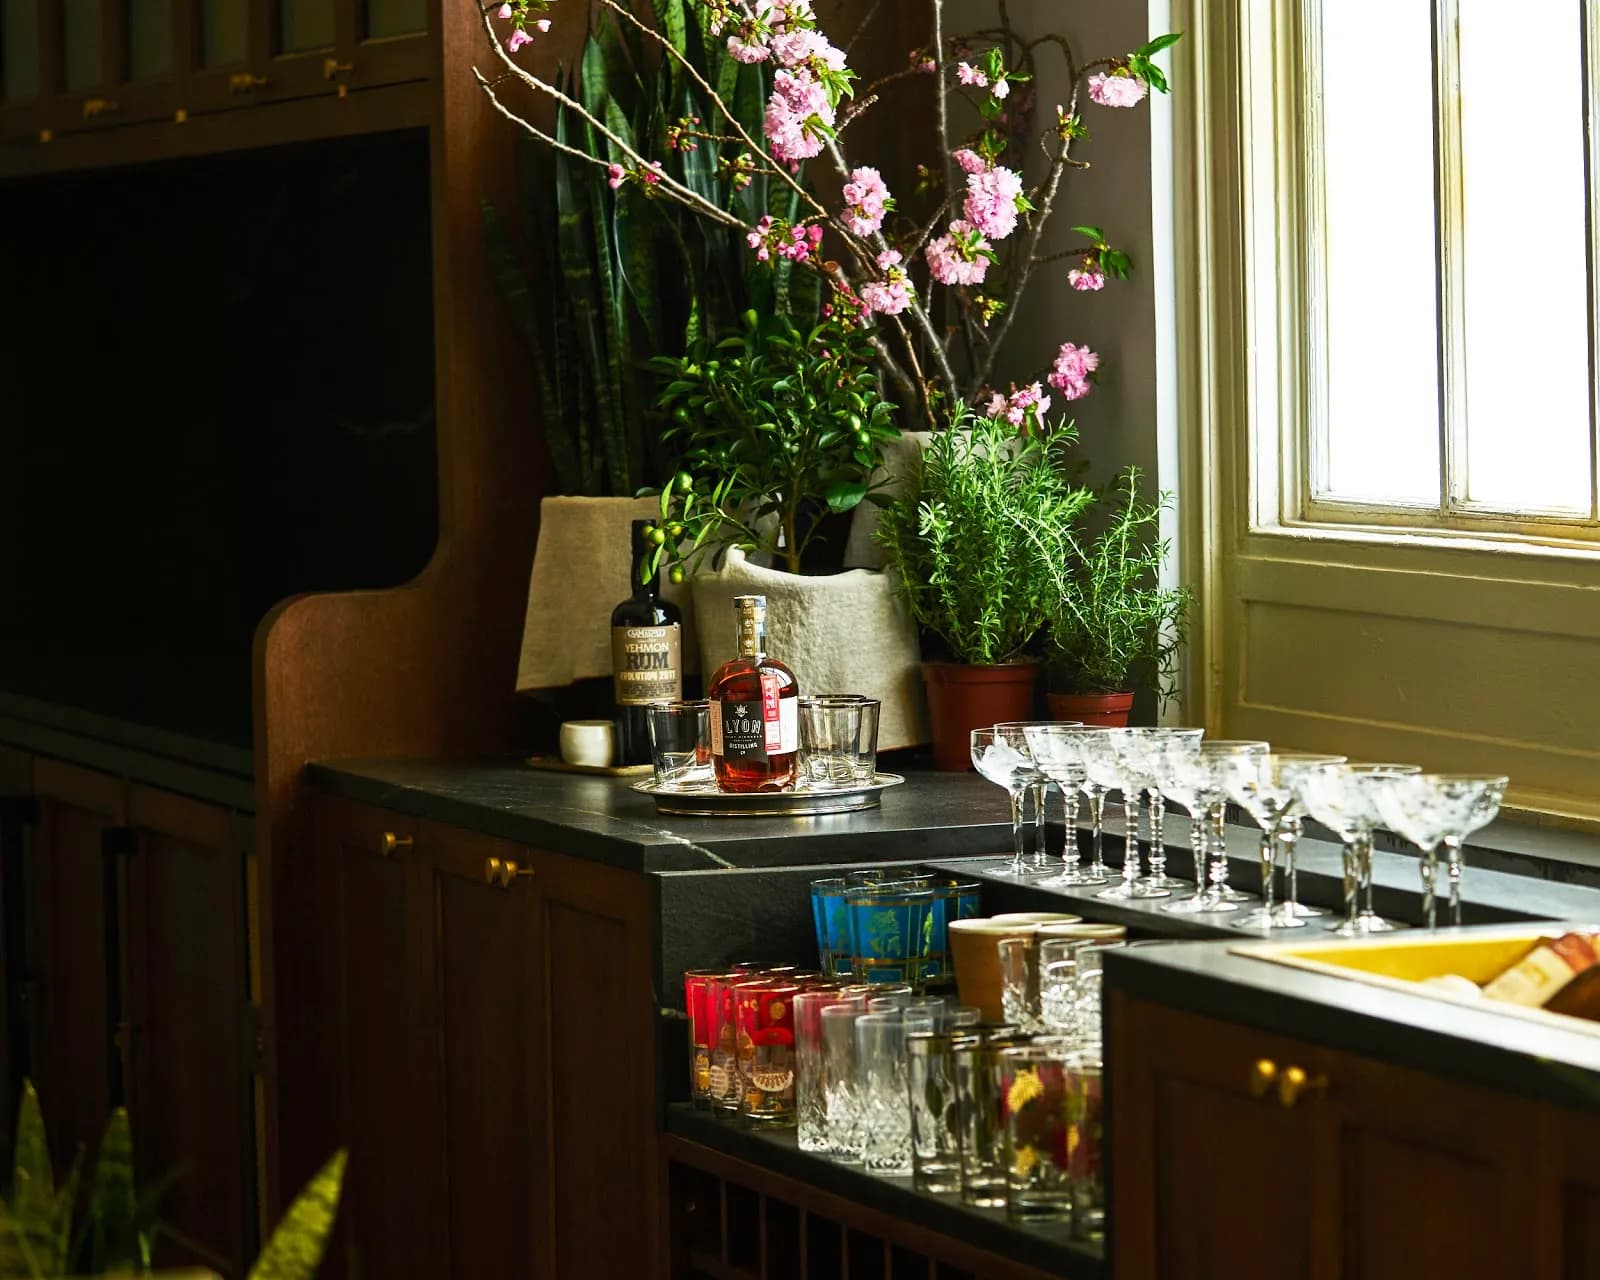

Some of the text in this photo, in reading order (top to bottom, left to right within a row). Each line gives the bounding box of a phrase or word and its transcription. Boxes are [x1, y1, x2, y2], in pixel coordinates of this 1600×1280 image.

[625, 641, 669, 652] YEHMON
[626, 652, 669, 669] RUM
[726, 719, 761, 733] LYON
[729, 742, 758, 750] DISTILLING
